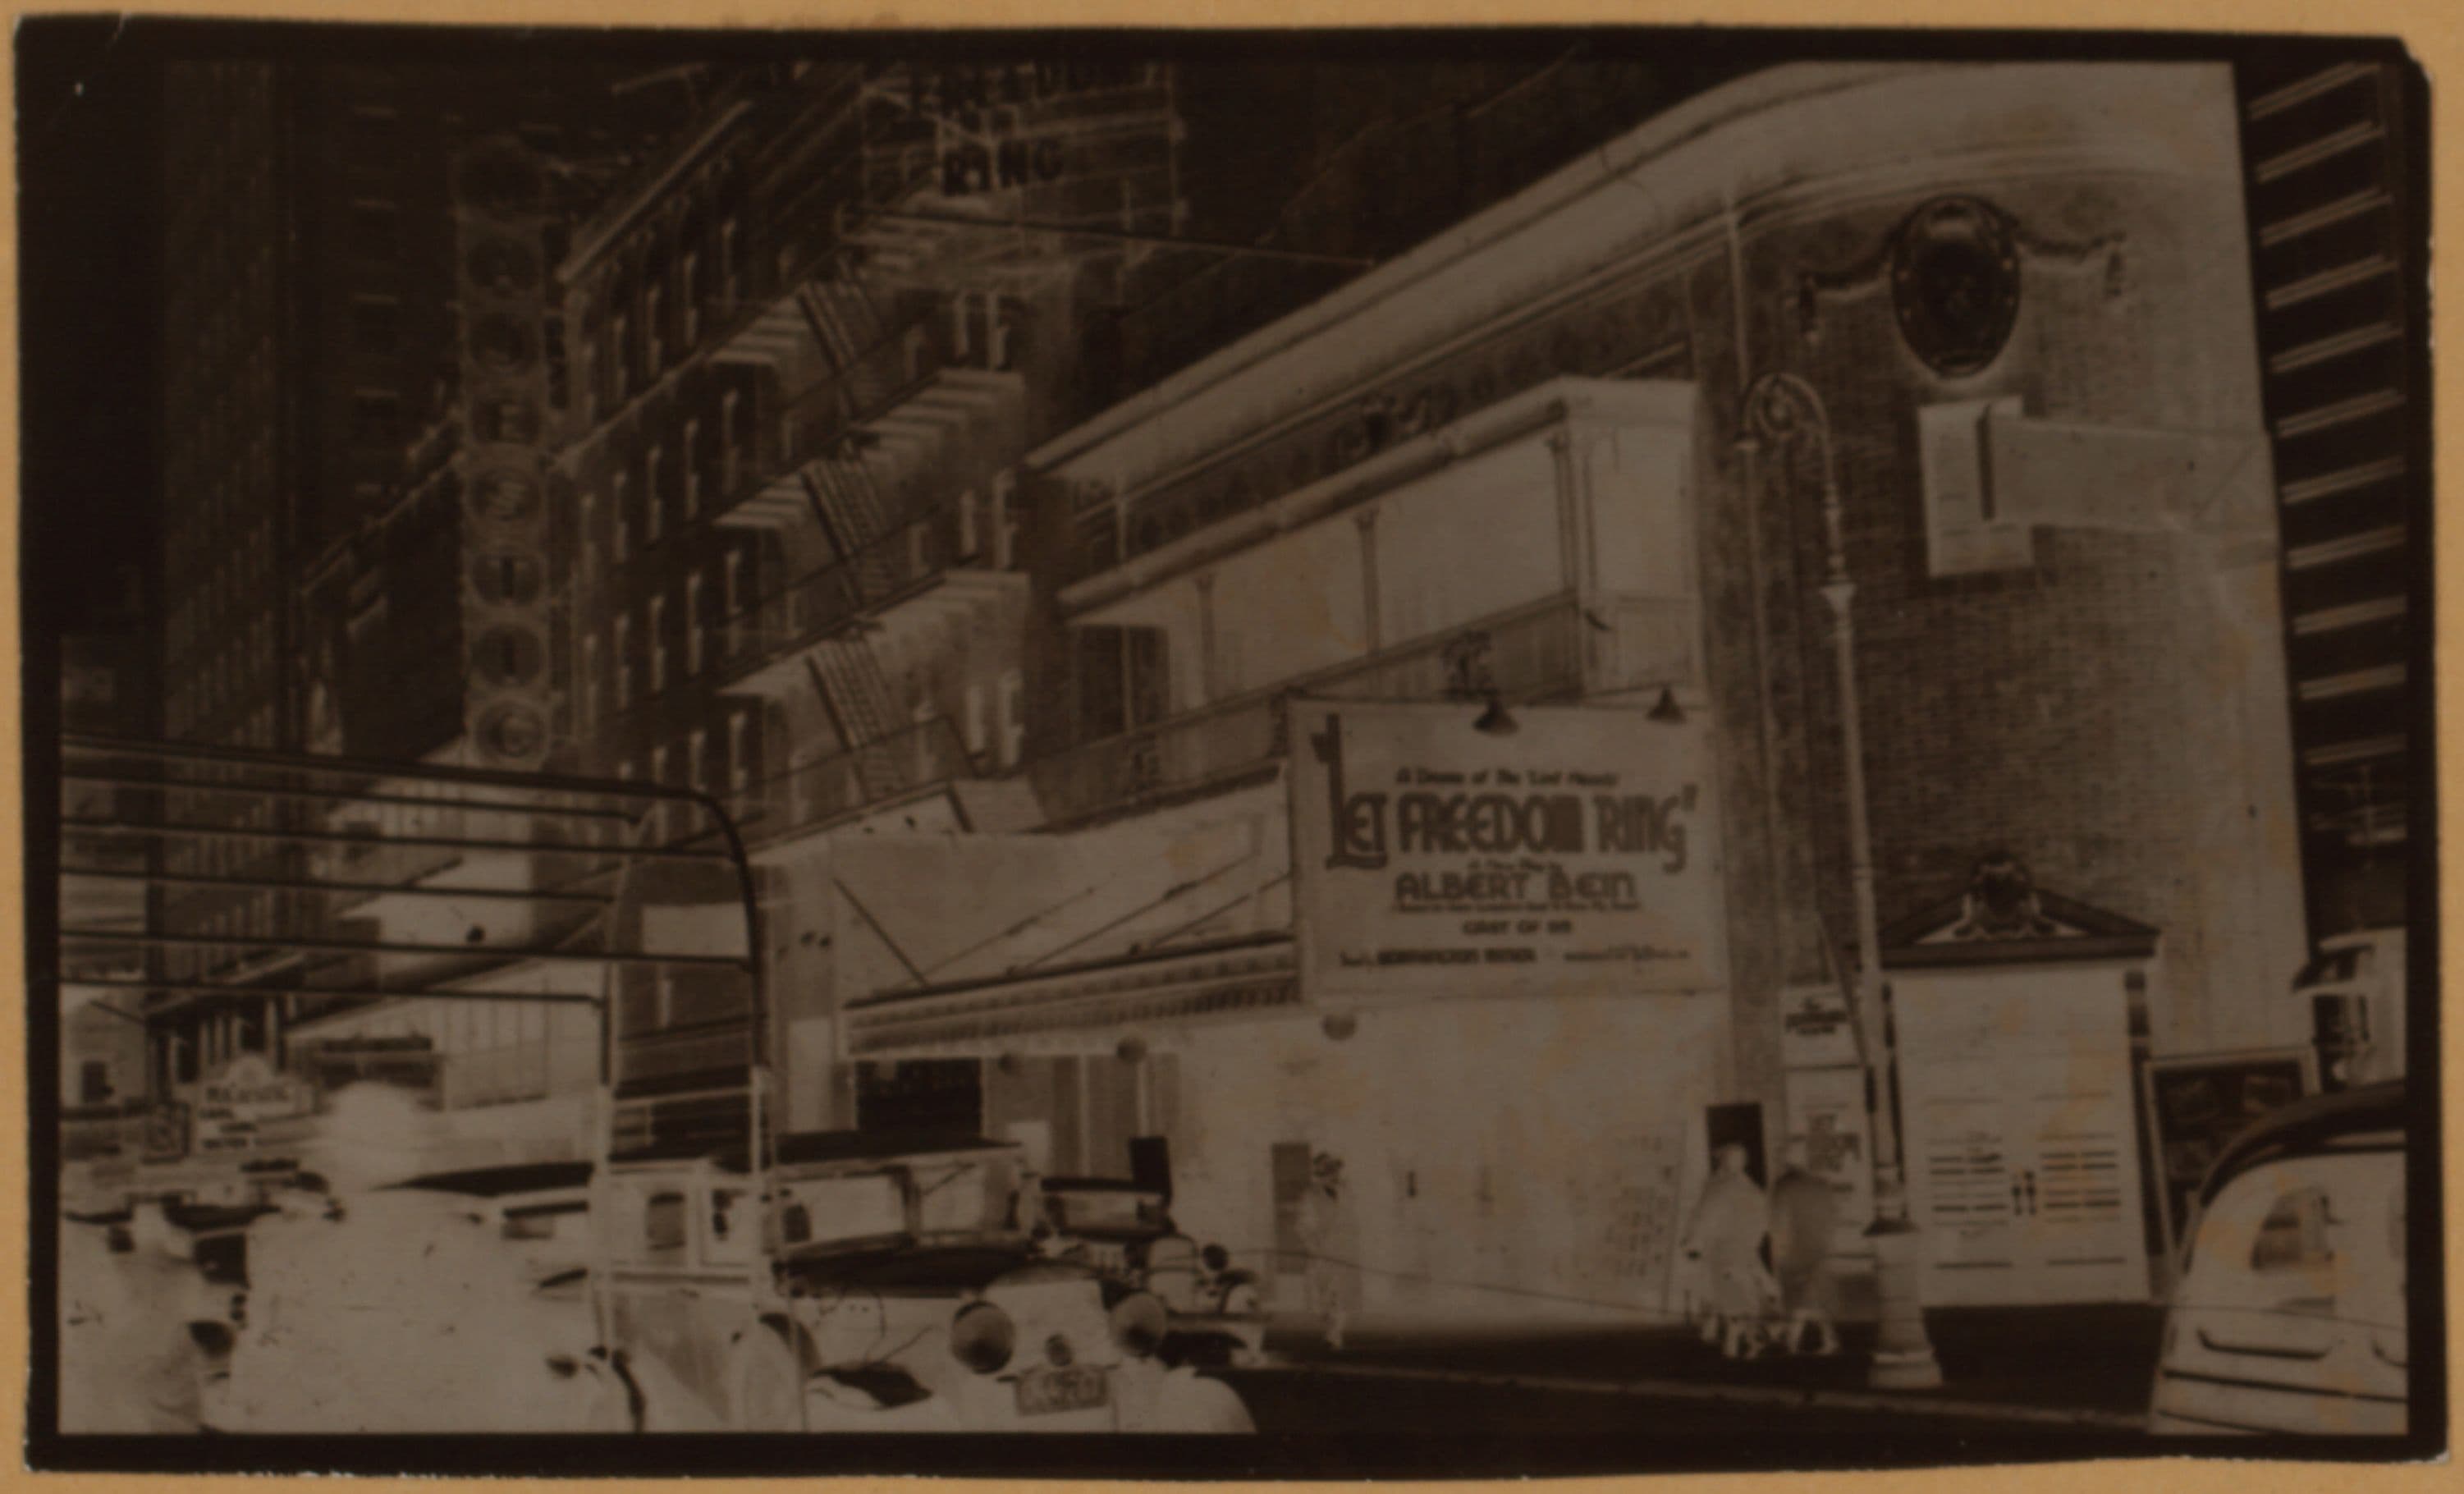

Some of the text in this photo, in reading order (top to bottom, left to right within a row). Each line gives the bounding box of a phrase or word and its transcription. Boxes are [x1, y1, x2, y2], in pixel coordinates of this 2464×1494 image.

[943, 137, 1065, 195] RING
[1397, 791, 1583, 854] FREEDOM
[1395, 869, 1638, 902] ALBERT BEIN
